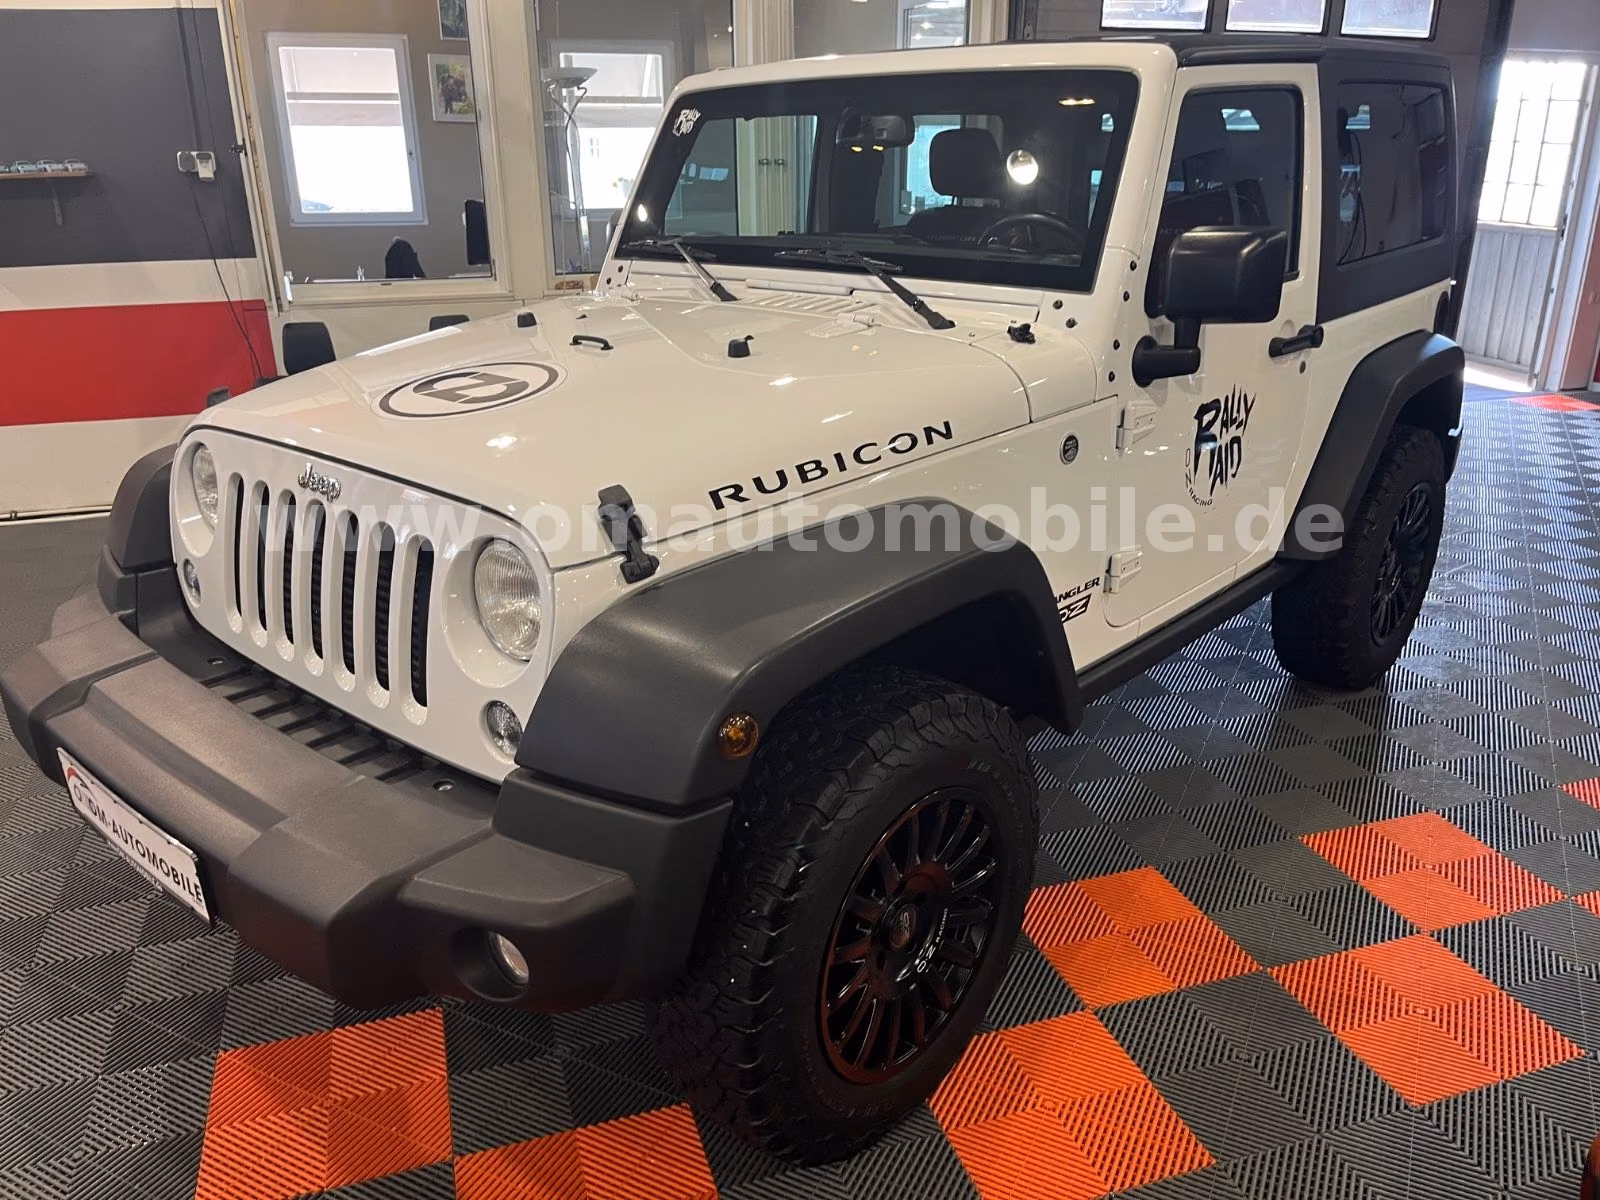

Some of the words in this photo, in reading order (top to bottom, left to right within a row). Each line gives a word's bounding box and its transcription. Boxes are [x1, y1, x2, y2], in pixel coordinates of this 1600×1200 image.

[1193, 383, 1257, 440] RALLY
[297, 462, 342, 503] Jeep
[707, 420, 954, 511] RUBICON
